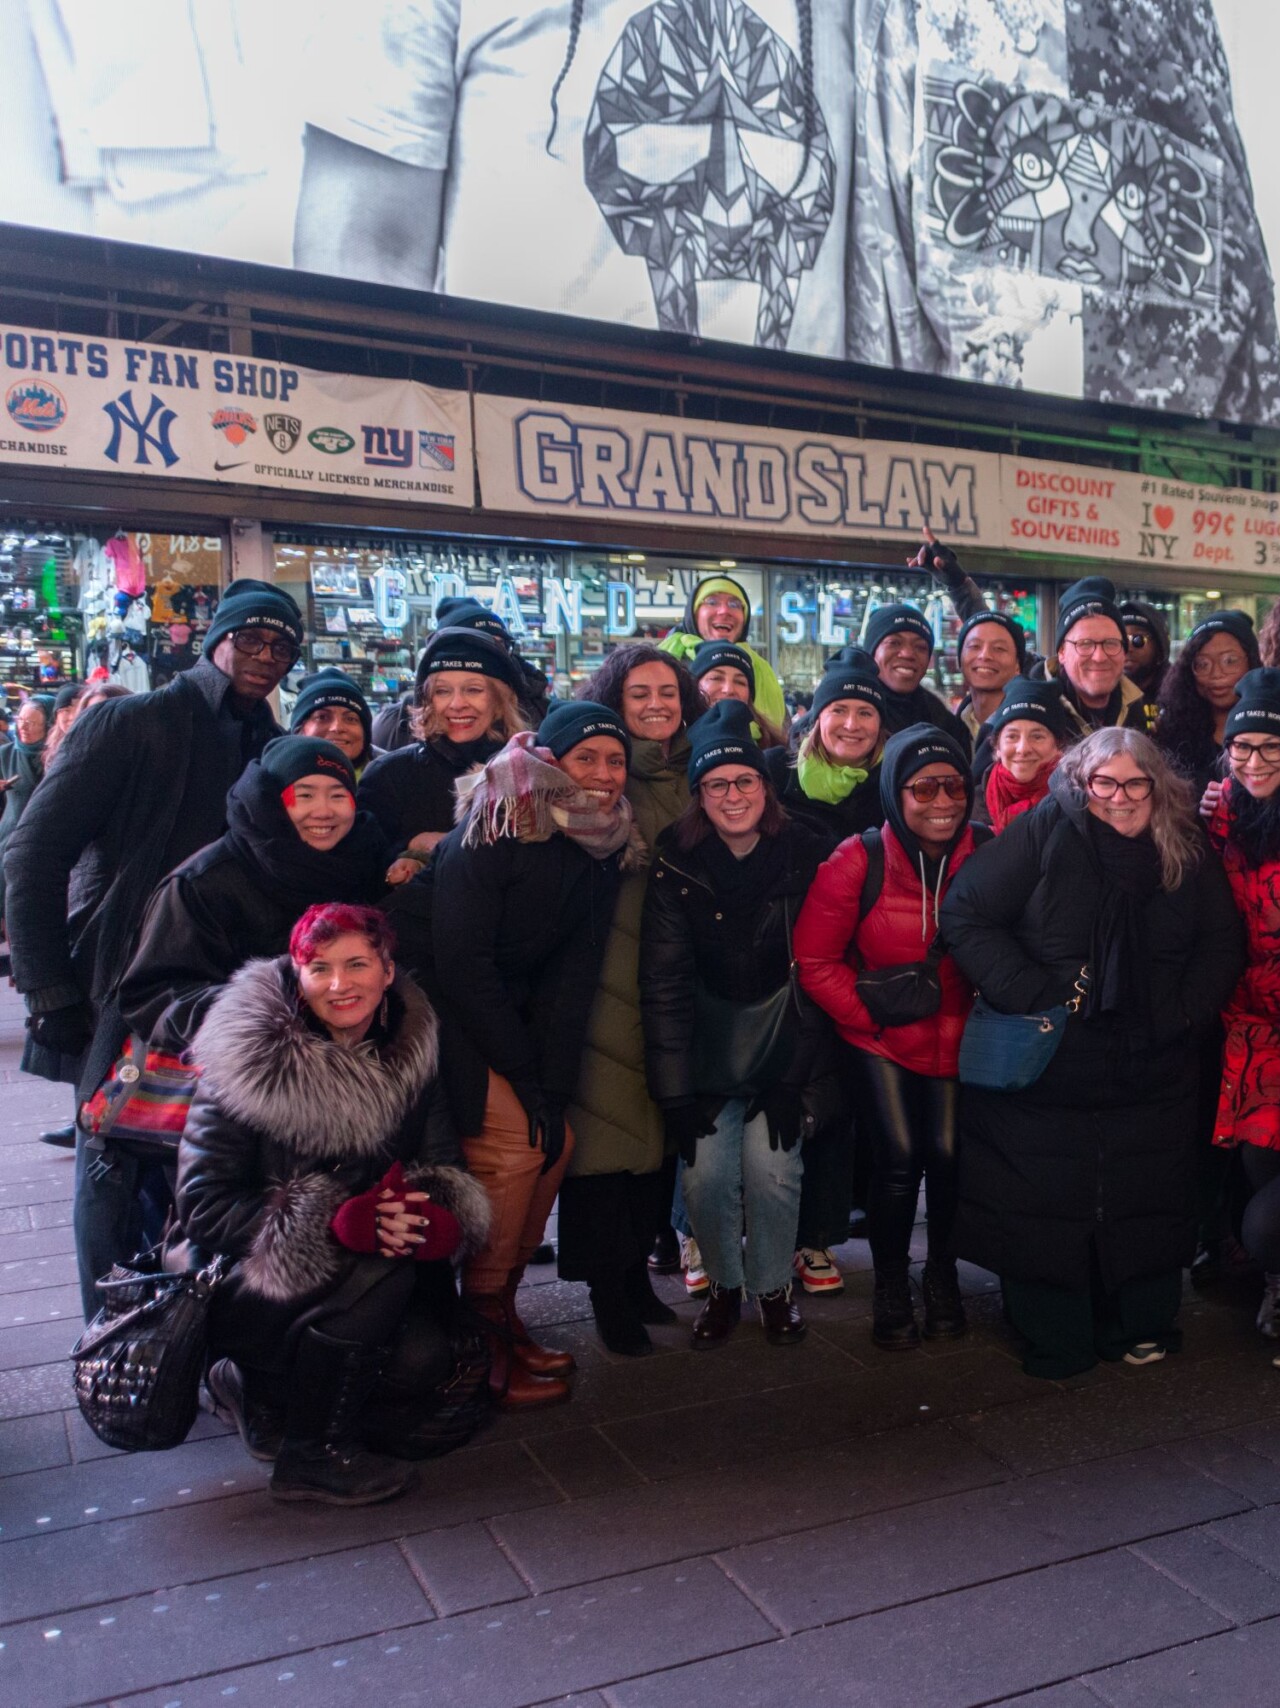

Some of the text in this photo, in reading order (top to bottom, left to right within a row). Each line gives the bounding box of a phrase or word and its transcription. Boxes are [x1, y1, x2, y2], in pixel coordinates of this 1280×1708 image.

[0, 332, 299, 402] ORTS FAN SHOP
[265, 414, 300, 435] NETS
[0, 440, 68, 456] CHANDISE
[254, 464, 454, 495] OFFICIALLY LICENSED MERCHANDISE
[1015, 469, 1116, 499] DISCOUNT
[1026, 496, 1099, 521] GIFTS &
[1141, 481, 1279, 513] #1 Rated Souvenir Shop
[1142, 502, 1152, 528] I
[1192, 510, 1236, 537] 99¢
[1010, 518, 1121, 547] SOUVENIRS
[1138, 532, 1179, 560] NY
[1193, 542, 1235, 564] Dept.
[1254, 540, 1268, 565] 3
[263, 617, 284, 627] TAKES
[857, 685, 873, 695] TAKES
[583, 725, 595, 734] ART
[704, 749, 722, 759] TAKES
[918, 747, 929, 755] ART
